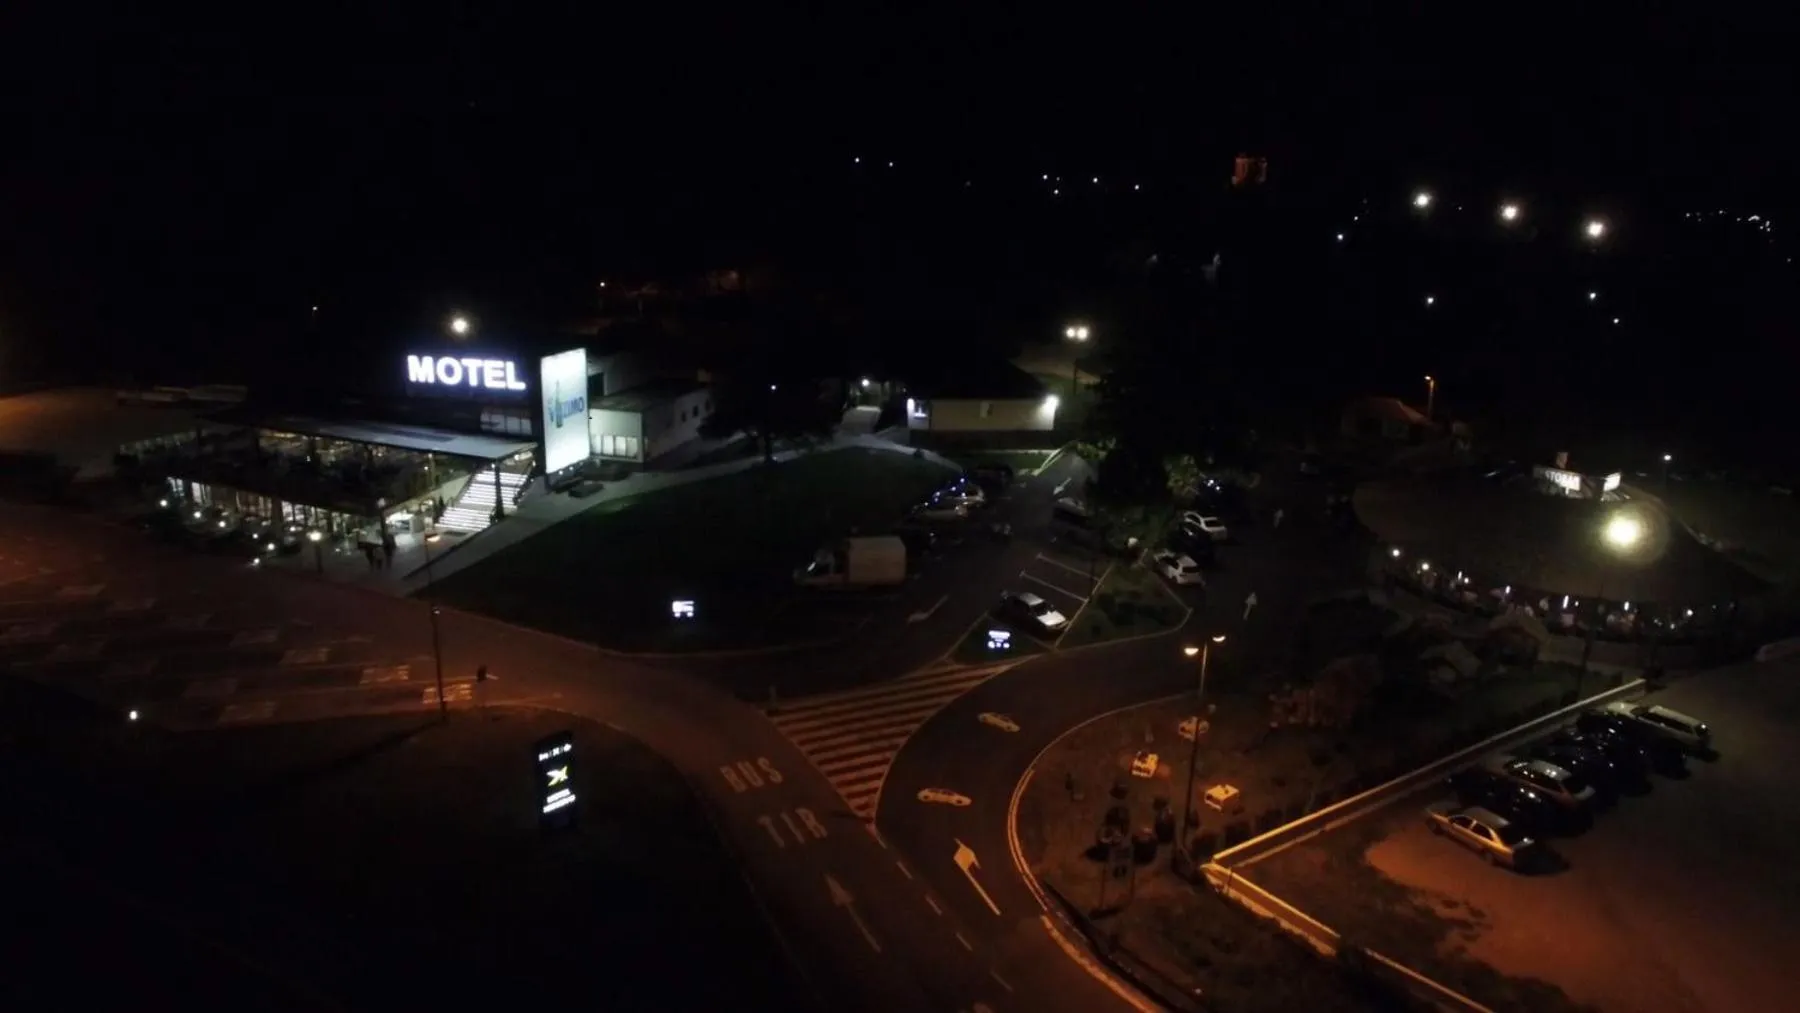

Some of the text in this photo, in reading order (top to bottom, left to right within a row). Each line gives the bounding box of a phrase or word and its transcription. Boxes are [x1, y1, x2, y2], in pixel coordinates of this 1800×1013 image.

[406, 354, 526, 391] MOTEL
[719, 756, 783, 793] BUS
[756, 807, 828, 848] TIR
